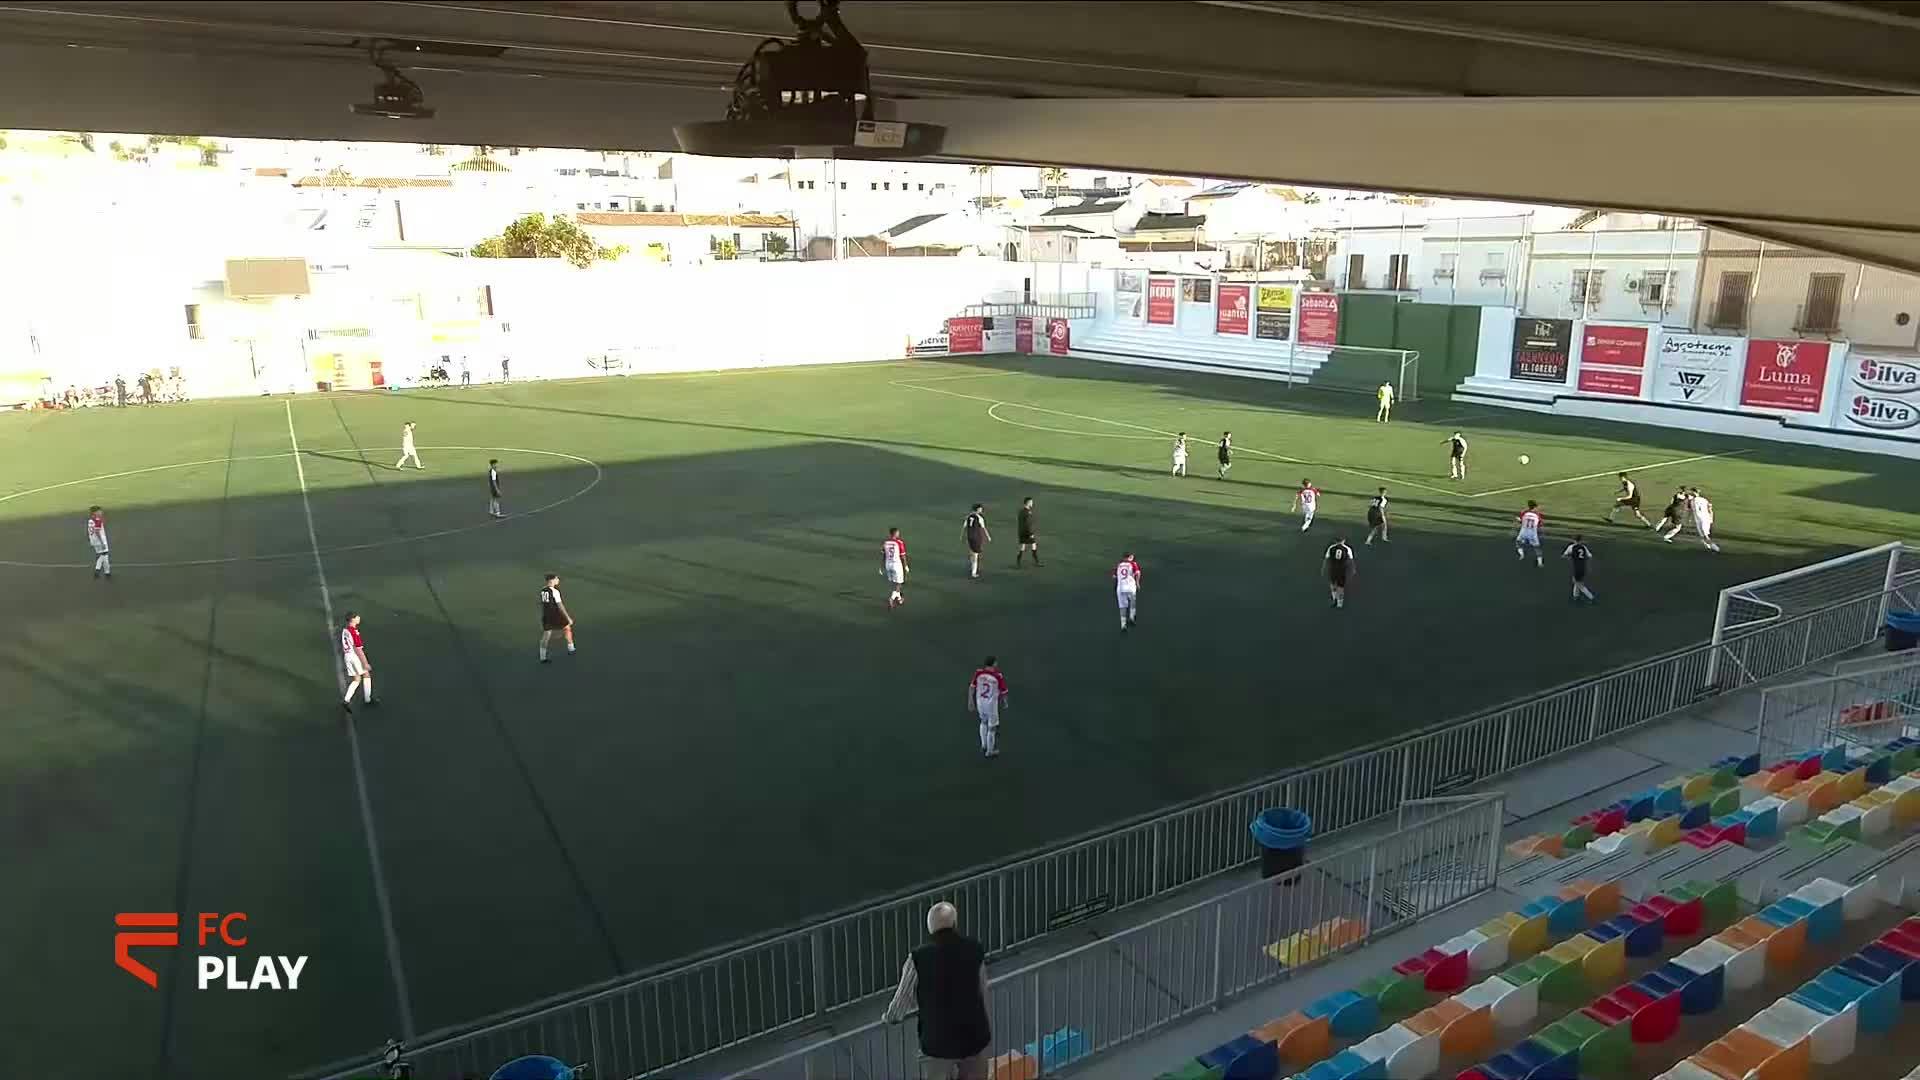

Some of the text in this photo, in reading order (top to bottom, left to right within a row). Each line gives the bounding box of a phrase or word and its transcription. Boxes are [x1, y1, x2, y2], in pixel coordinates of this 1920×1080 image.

[1759, 366, 1811, 384] Luma
[1859, 359, 1917, 383] Silva
[1852, 395, 1910, 420] Silva
[1120, 568, 1129, 580] 9
[541, 591, 550, 603] 10
[980, 683, 990, 698] 2
